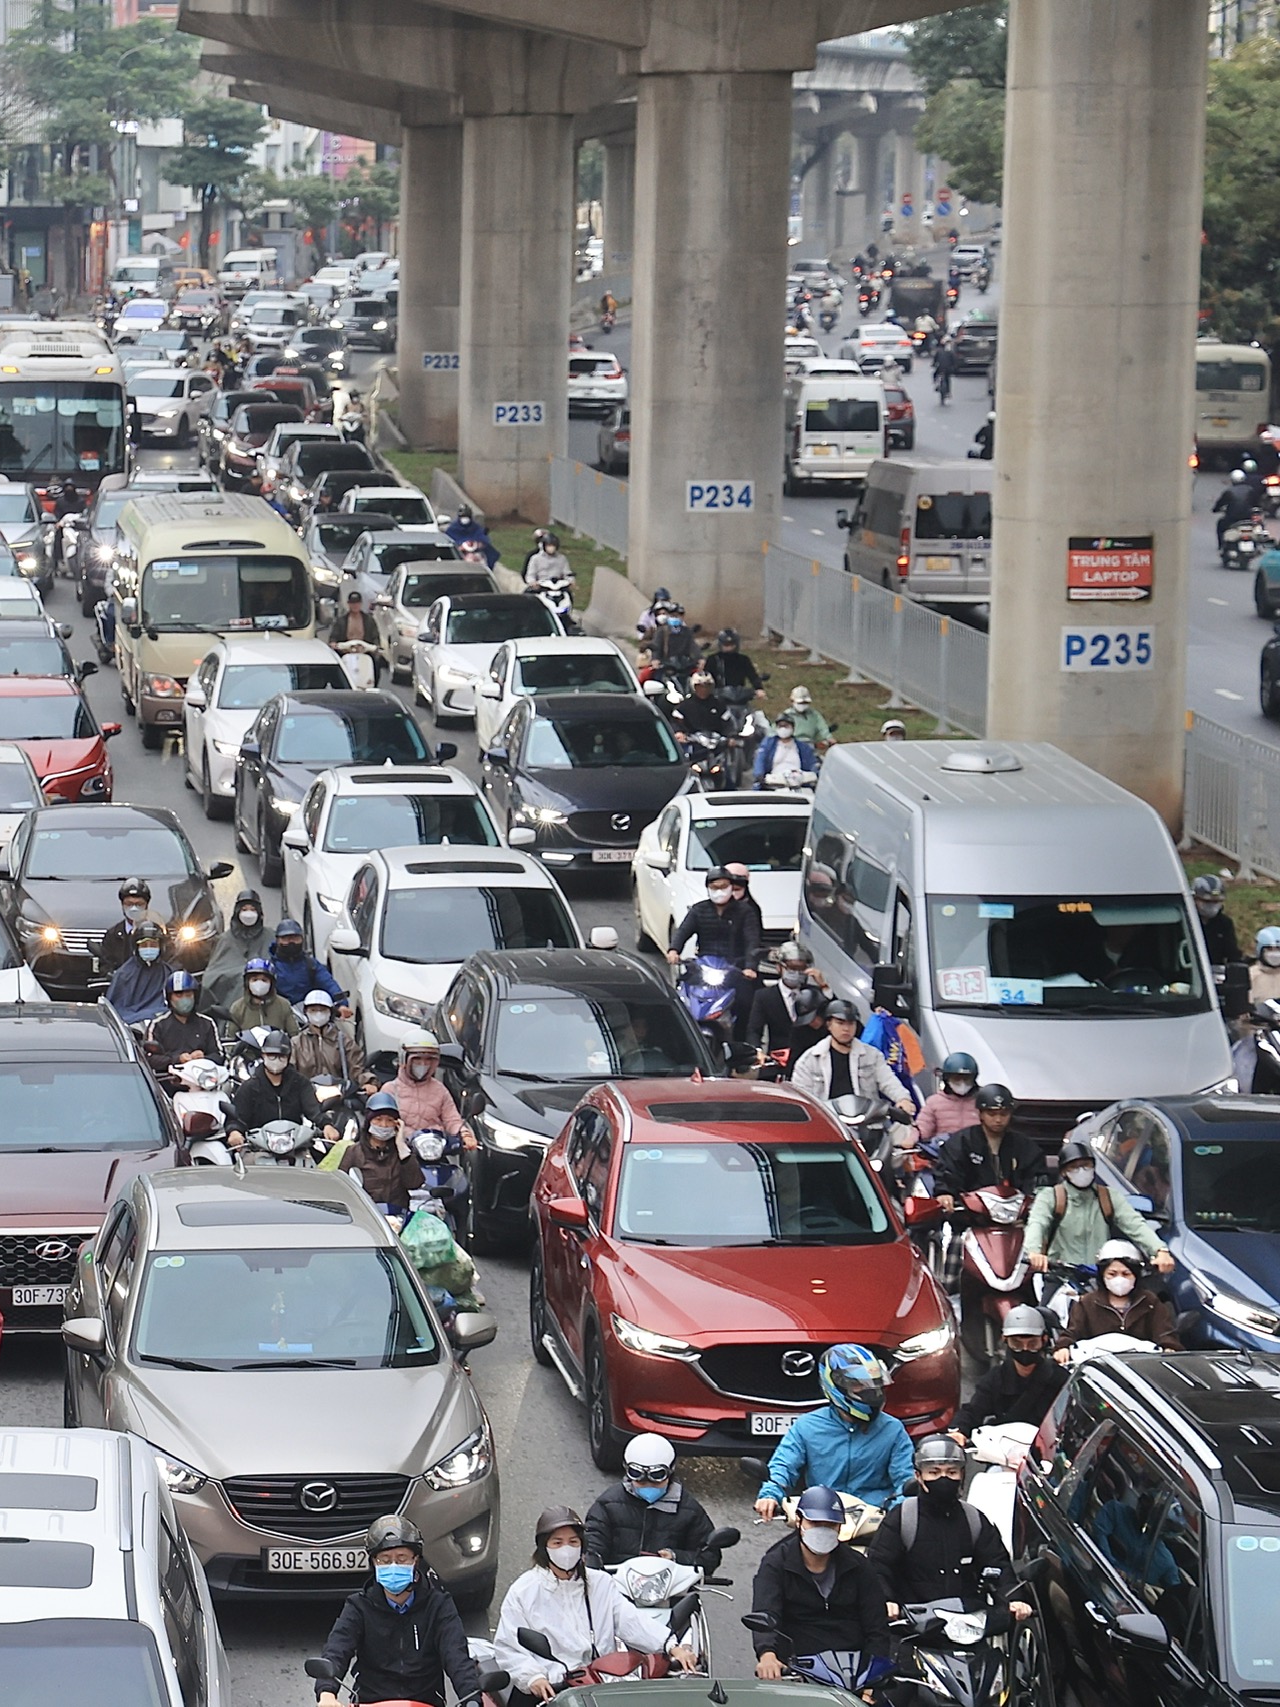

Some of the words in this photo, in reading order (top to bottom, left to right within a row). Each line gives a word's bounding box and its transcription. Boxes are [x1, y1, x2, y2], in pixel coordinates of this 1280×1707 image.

[424, 355, 460, 369] P232
[496, 405, 542, 422] P233
[690, 485, 752, 508] P234
[1072, 555, 1121, 567] TRUNG
[1123, 552, 1151, 567] TÂM
[1083, 571, 1139, 583] LAPTOP
[1066, 632, 1151, 666] P235
[1001, 989, 1025, 1001] 34
[271, 1551, 367, 1570] 30E-566.92
